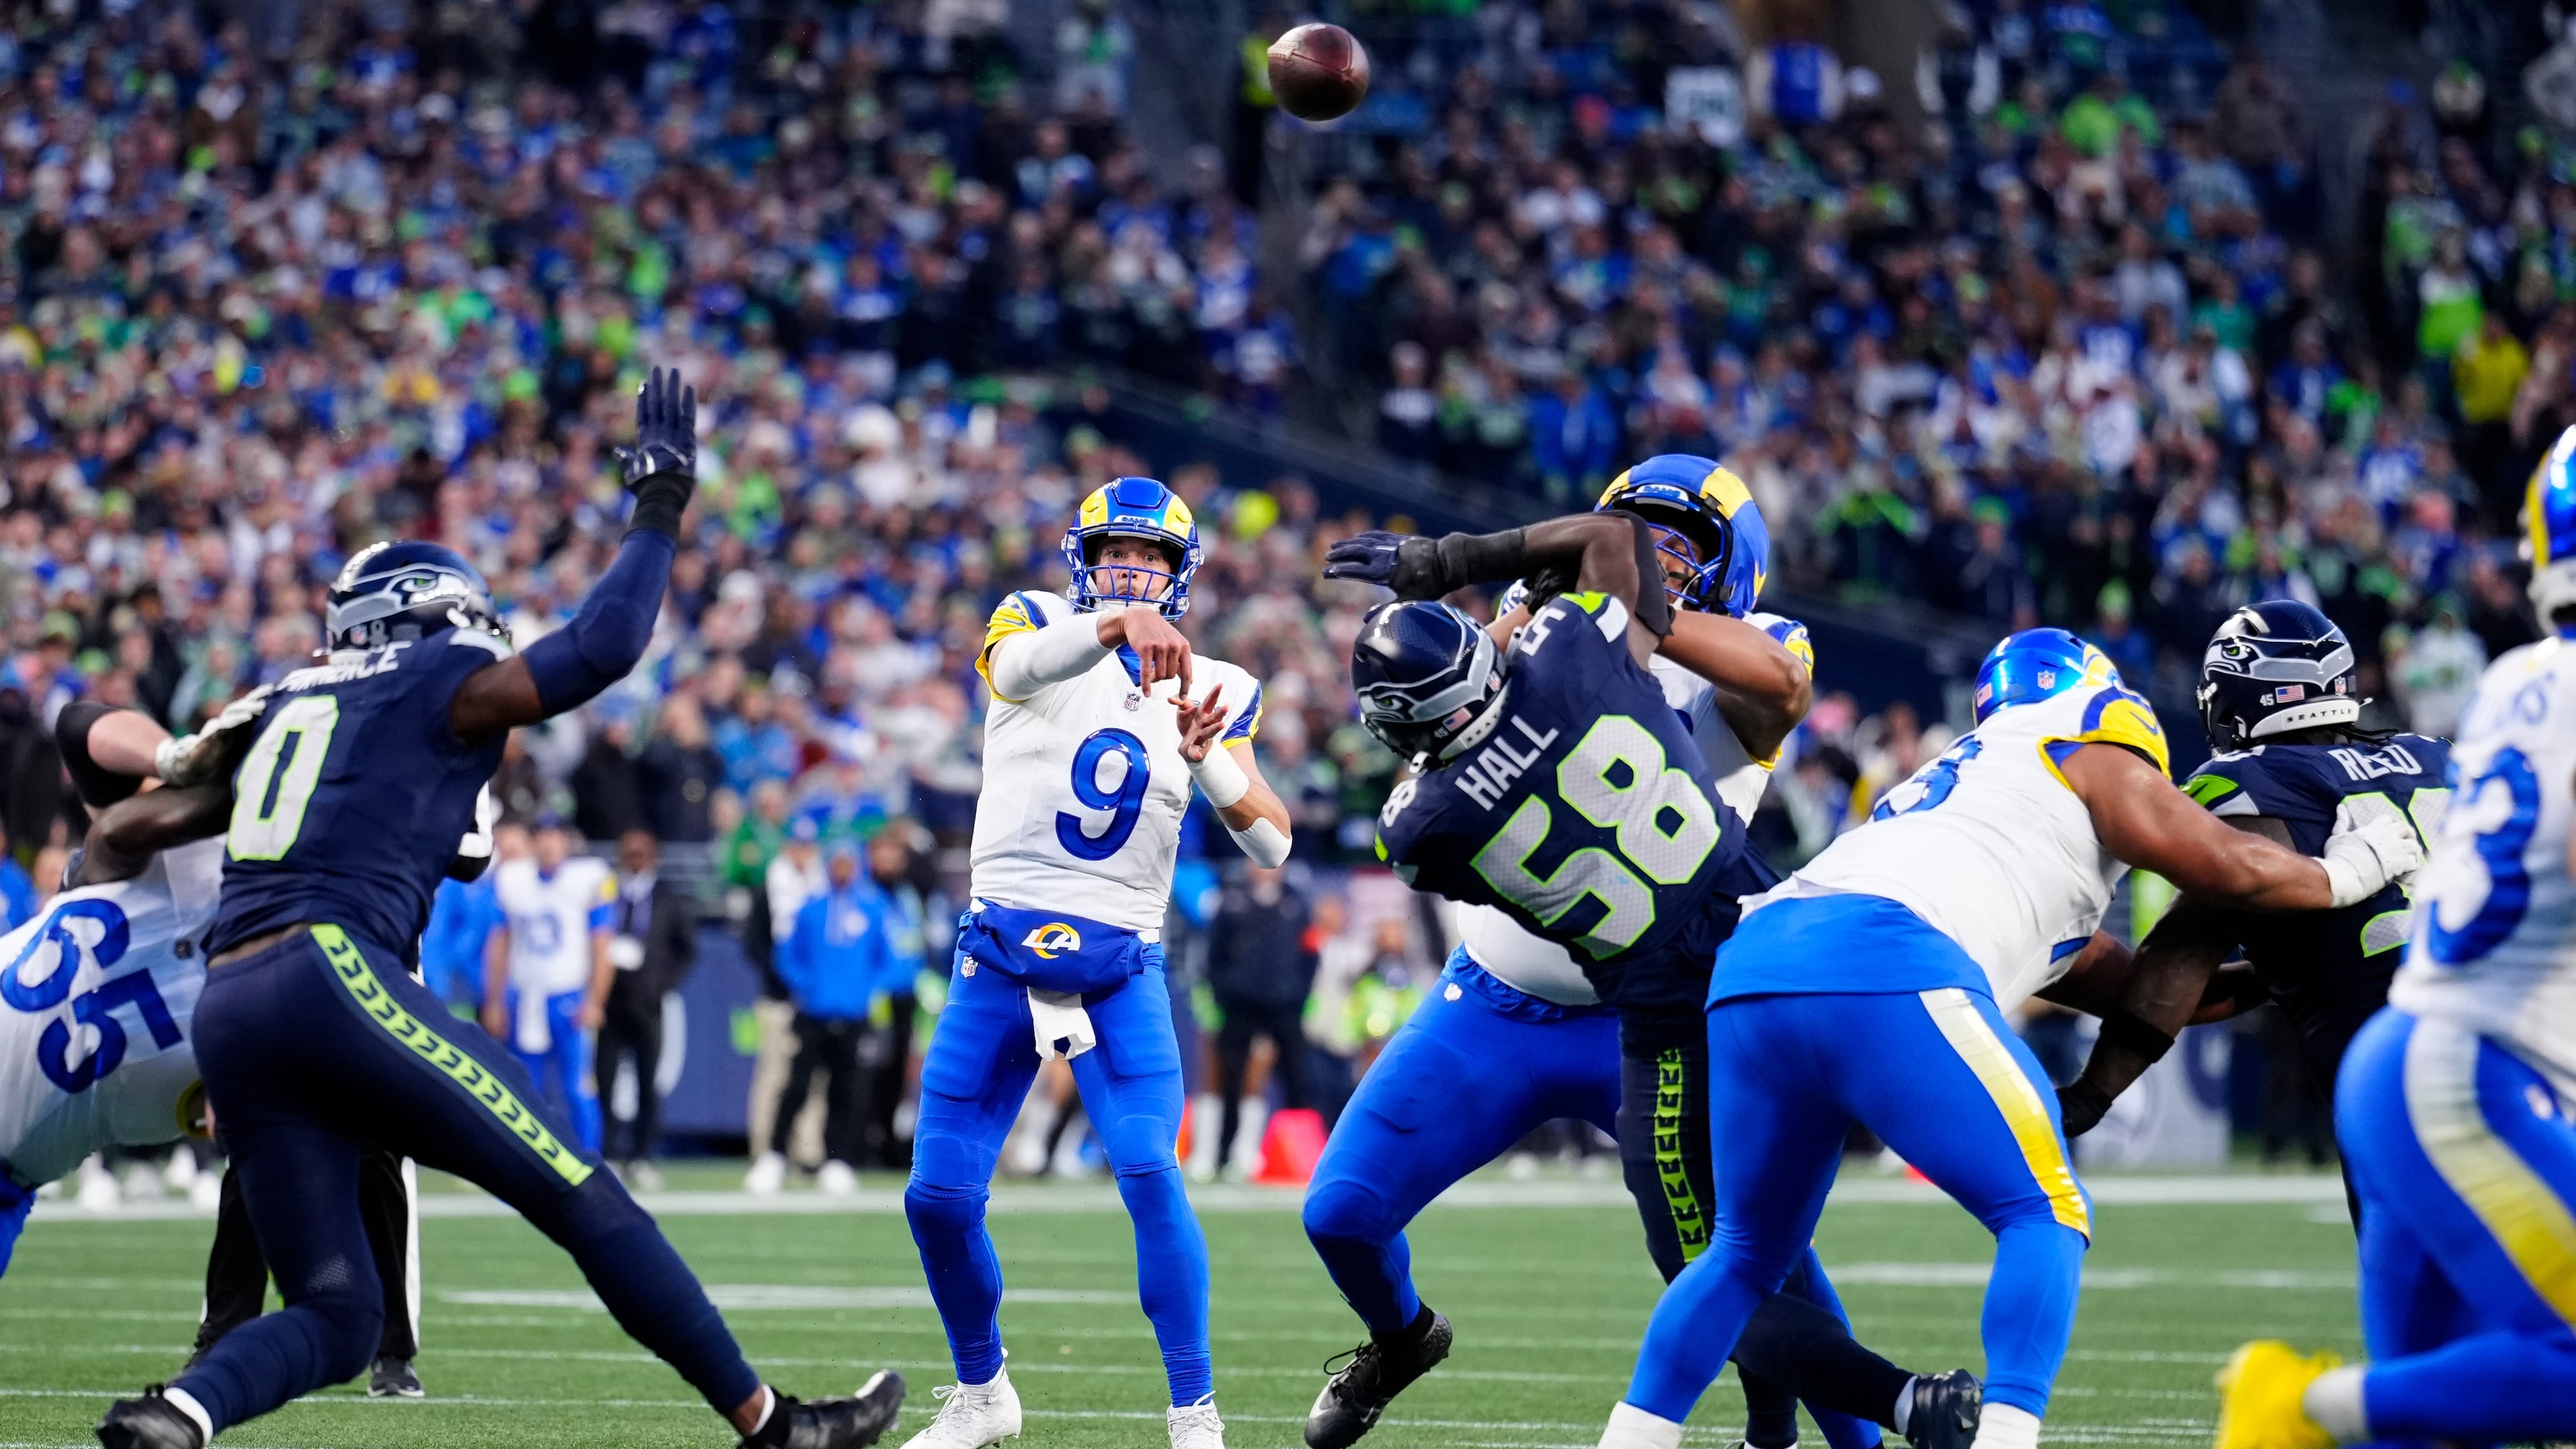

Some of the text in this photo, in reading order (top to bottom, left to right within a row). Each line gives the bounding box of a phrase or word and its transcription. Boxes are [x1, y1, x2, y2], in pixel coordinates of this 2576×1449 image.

[2259, 694, 2275, 706] 45
[227, 694, 339, 862] 0
[1055, 727, 1150, 861] 9
[1454, 715, 1560, 812] HALL
[2327, 744, 2423, 781] REED
[1469, 713, 1721, 962] 58
[1, 898, 184, 1095] 65
[1021, 924, 1081, 956] LA
